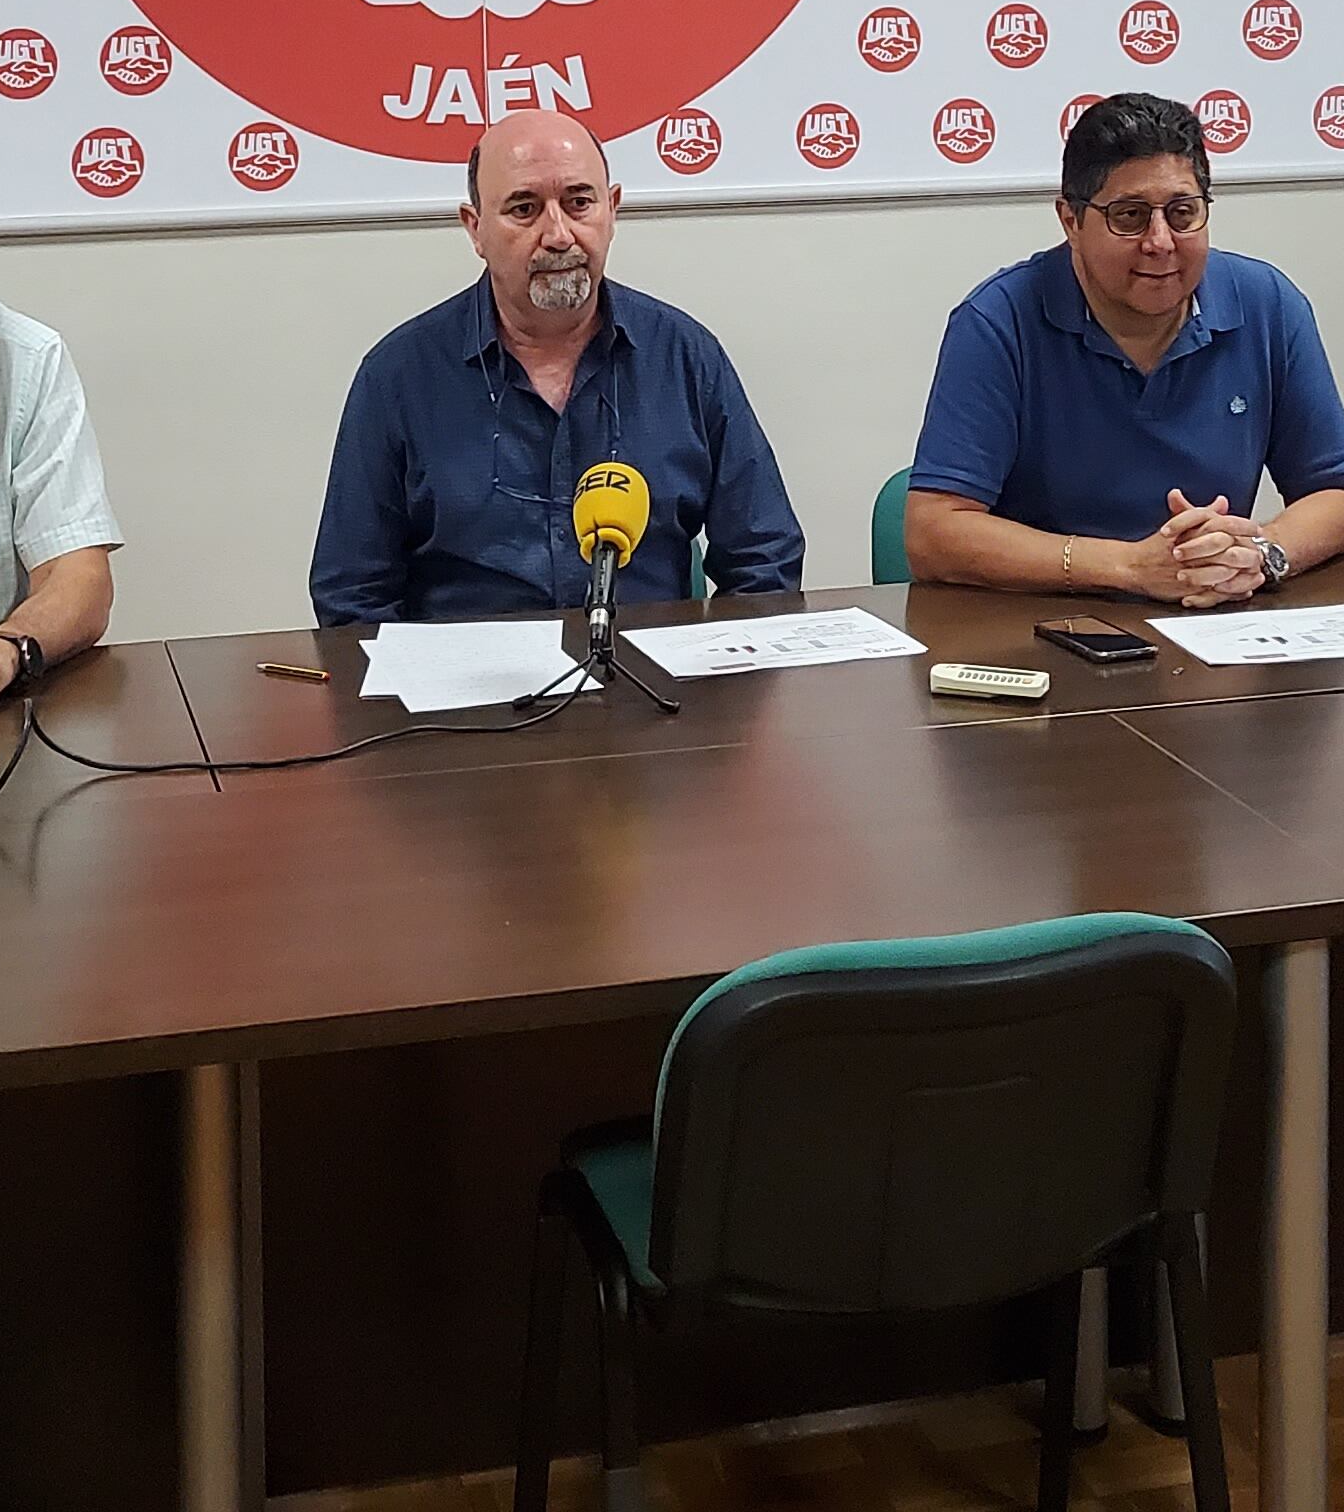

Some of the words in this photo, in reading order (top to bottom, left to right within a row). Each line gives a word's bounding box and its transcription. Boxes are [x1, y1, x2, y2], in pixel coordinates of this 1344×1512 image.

[866, 17, 911, 41] UGT
[994, 13, 1038, 37] UGT
[1128, 10, 1171, 33] UGT
[1251, 6, 1292, 29] UGT
[109, 36, 161, 61] UGT
[382, 54, 592, 124] JAÉN
[942, 108, 985, 132] UGT
[1199, 99, 1242, 120] UGT
[665, 119, 712, 143] UGT
[805, 113, 850, 137] UGT
[81, 138, 133, 163] UGT
[238, 133, 287, 158] UGT
